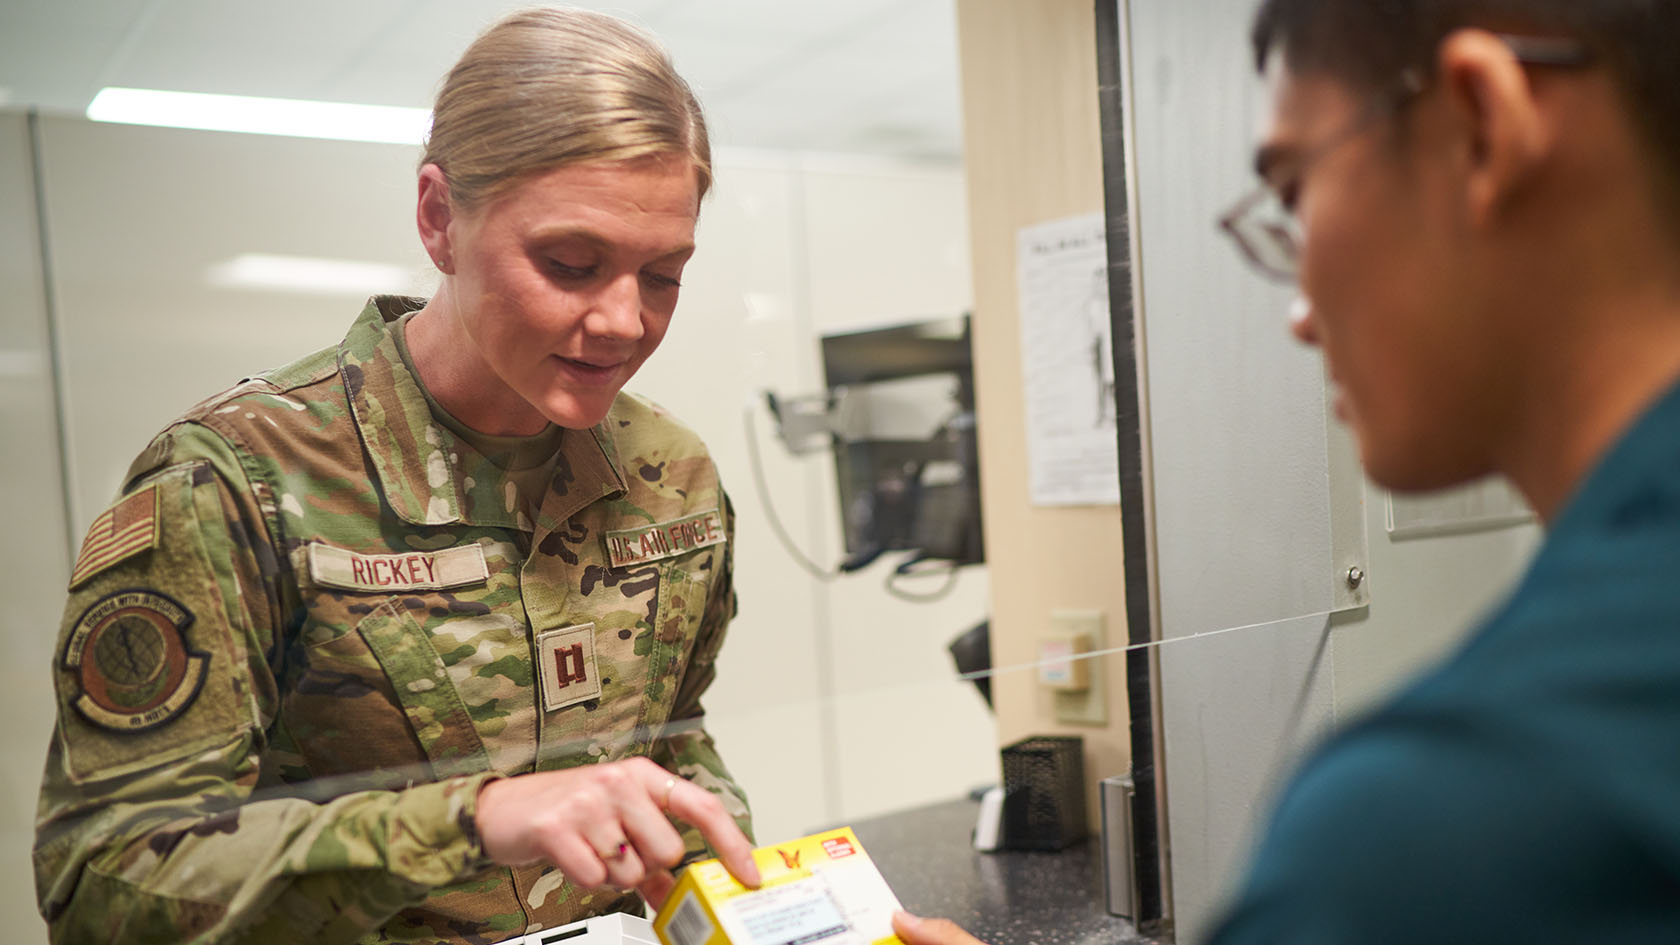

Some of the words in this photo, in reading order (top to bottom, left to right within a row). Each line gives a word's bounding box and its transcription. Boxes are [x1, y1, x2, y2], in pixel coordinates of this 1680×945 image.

[639, 529, 670, 558] AIR
[668, 515, 718, 550] FORCE
[351, 555, 435, 586] RICKEY
